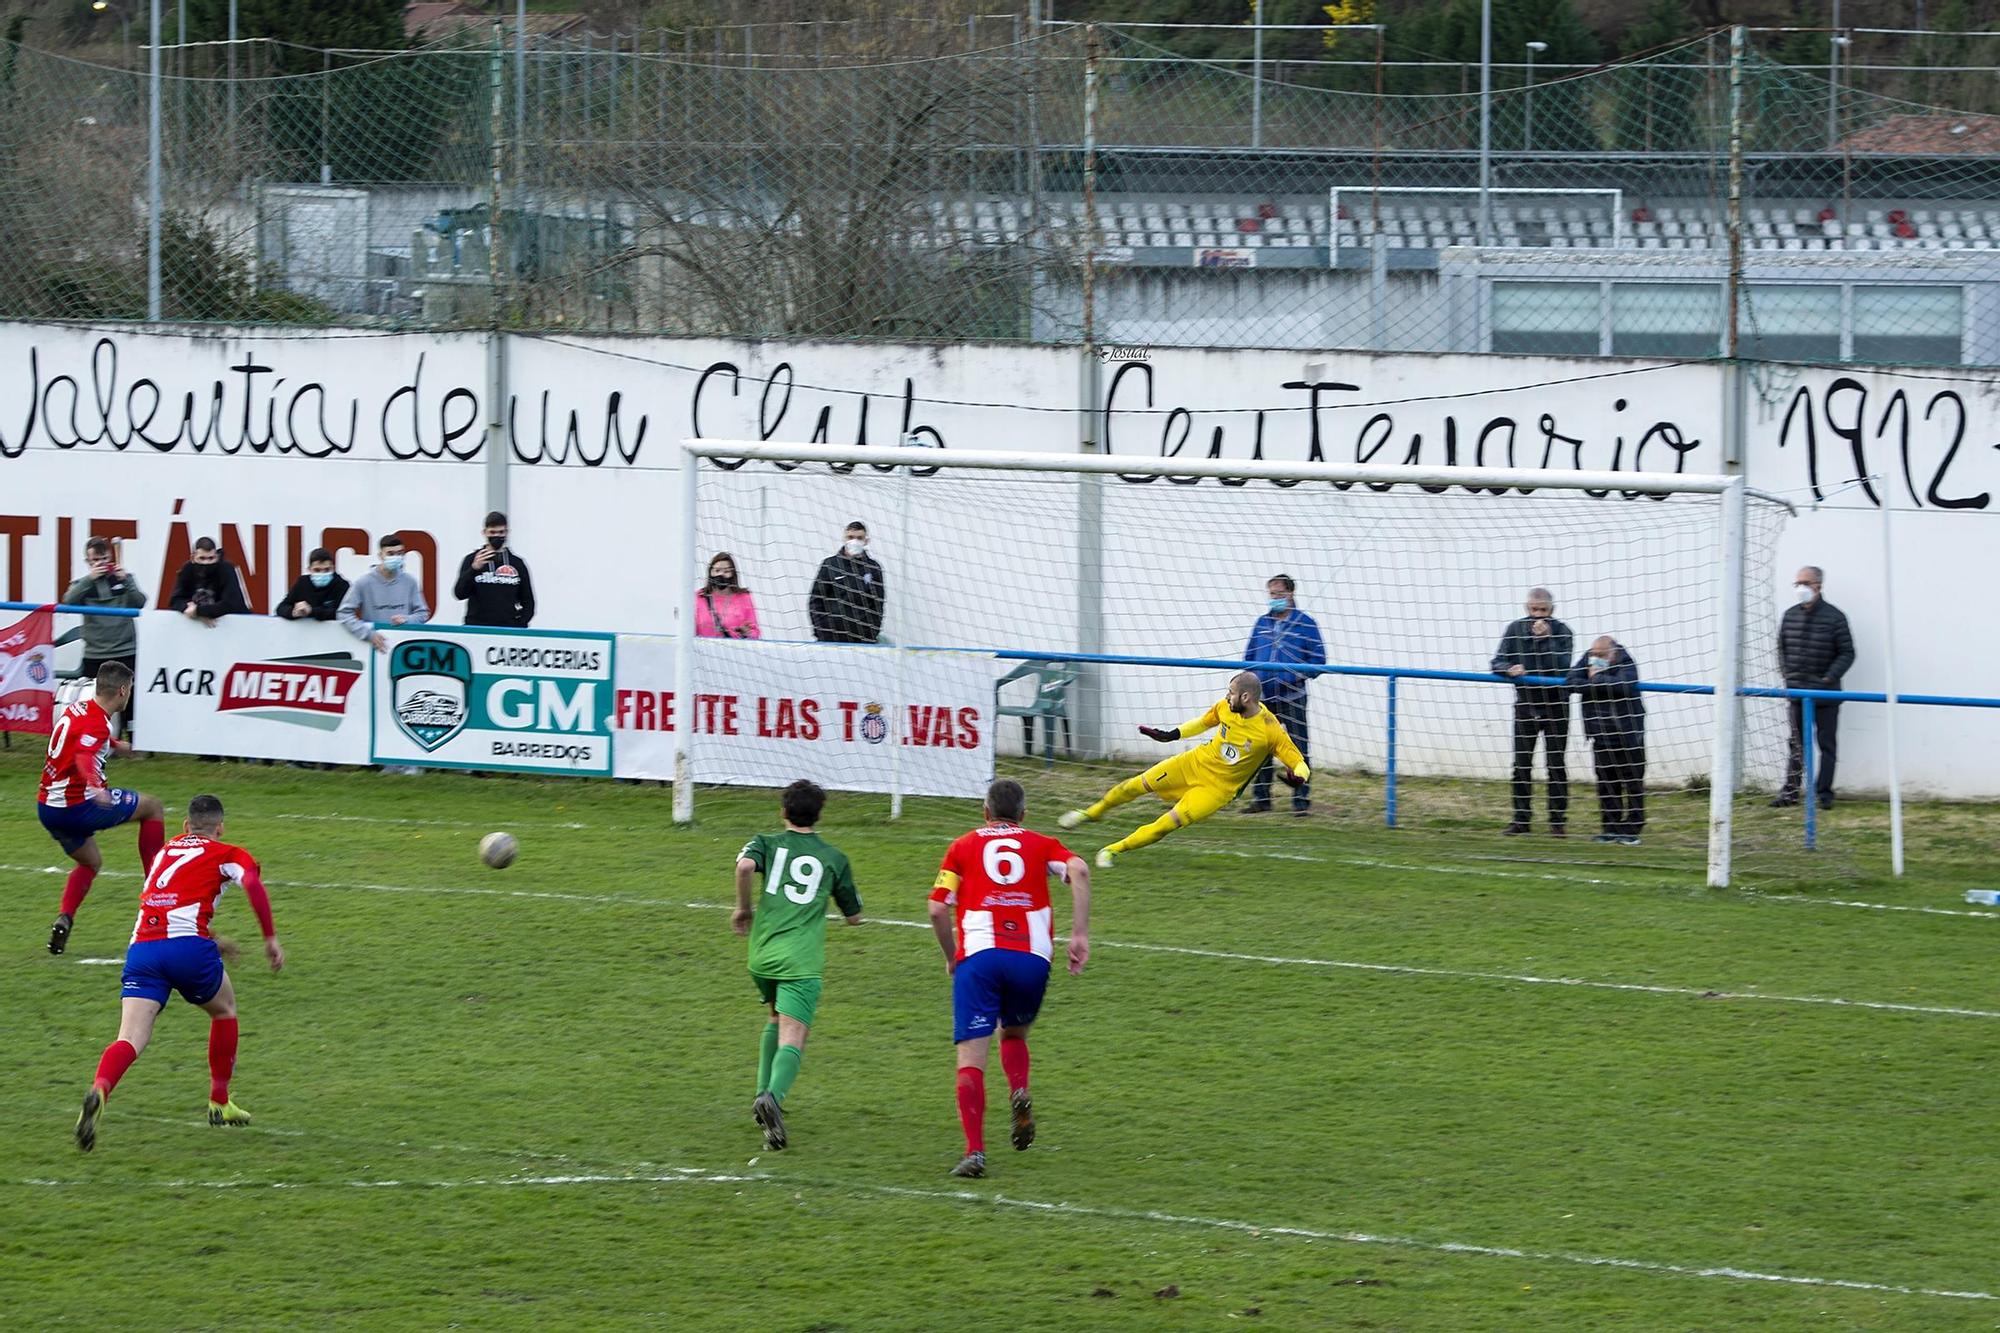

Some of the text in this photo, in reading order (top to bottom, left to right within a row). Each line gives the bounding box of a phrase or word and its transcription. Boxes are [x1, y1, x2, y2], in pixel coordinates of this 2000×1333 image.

[382, 351, 488, 461] de
[693, 362, 945, 477] Club
[1779, 377, 1991, 510] 1912
[402, 646, 456, 672] GM
[486, 646, 601, 670] CARROCERIAS
[147, 667, 345, 704] AGR METAL
[486, 678, 598, 732] GM
[616, 689, 980, 750] FRETE LAS TVAS
[492, 741, 592, 760] BARREDOS
[765, 847, 824, 905] 19
[983, 838, 1026, 885] 6
